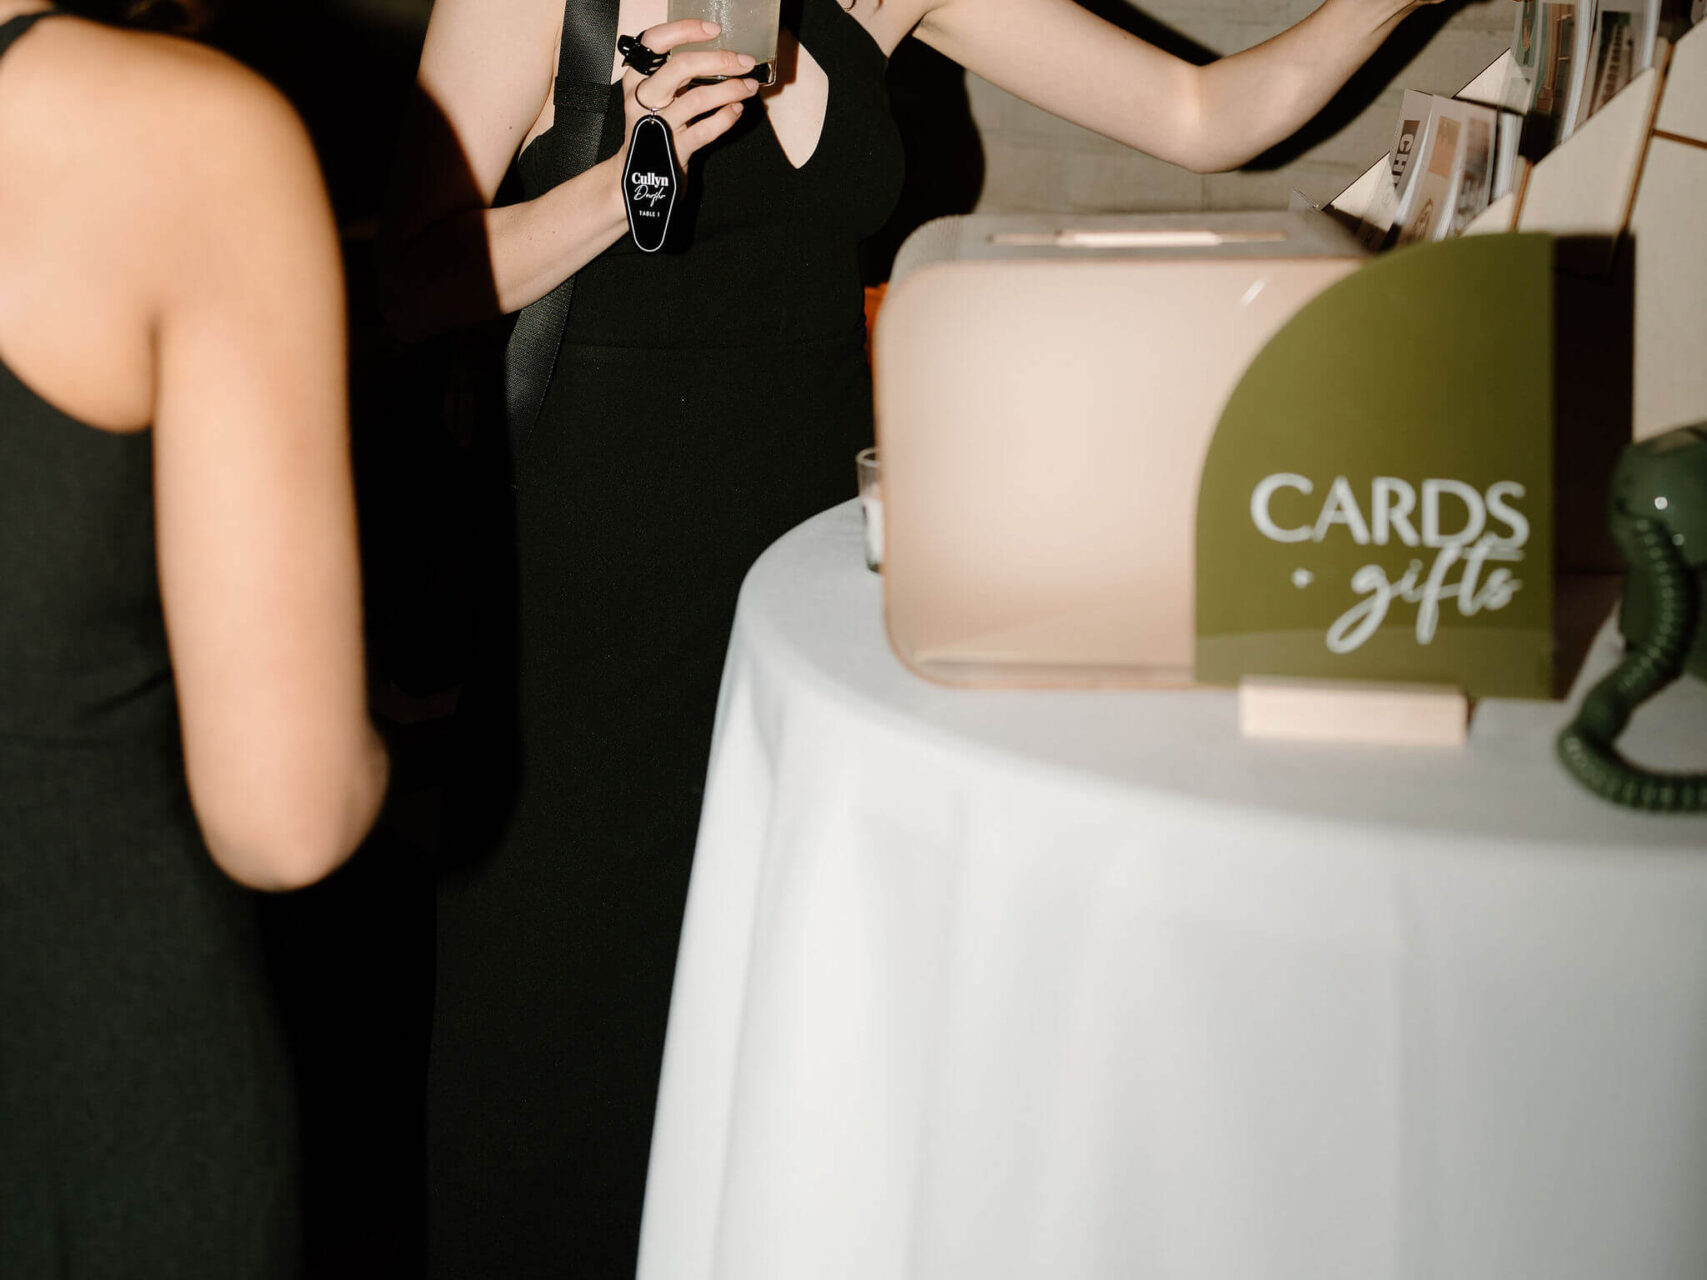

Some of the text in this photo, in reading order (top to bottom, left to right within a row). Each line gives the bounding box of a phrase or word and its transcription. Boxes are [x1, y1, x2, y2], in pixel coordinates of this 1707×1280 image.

[639, 210, 656, 218] TABLE
[1250, 472, 1530, 549] CARDS
[1326, 532, 1525, 654] gifts
